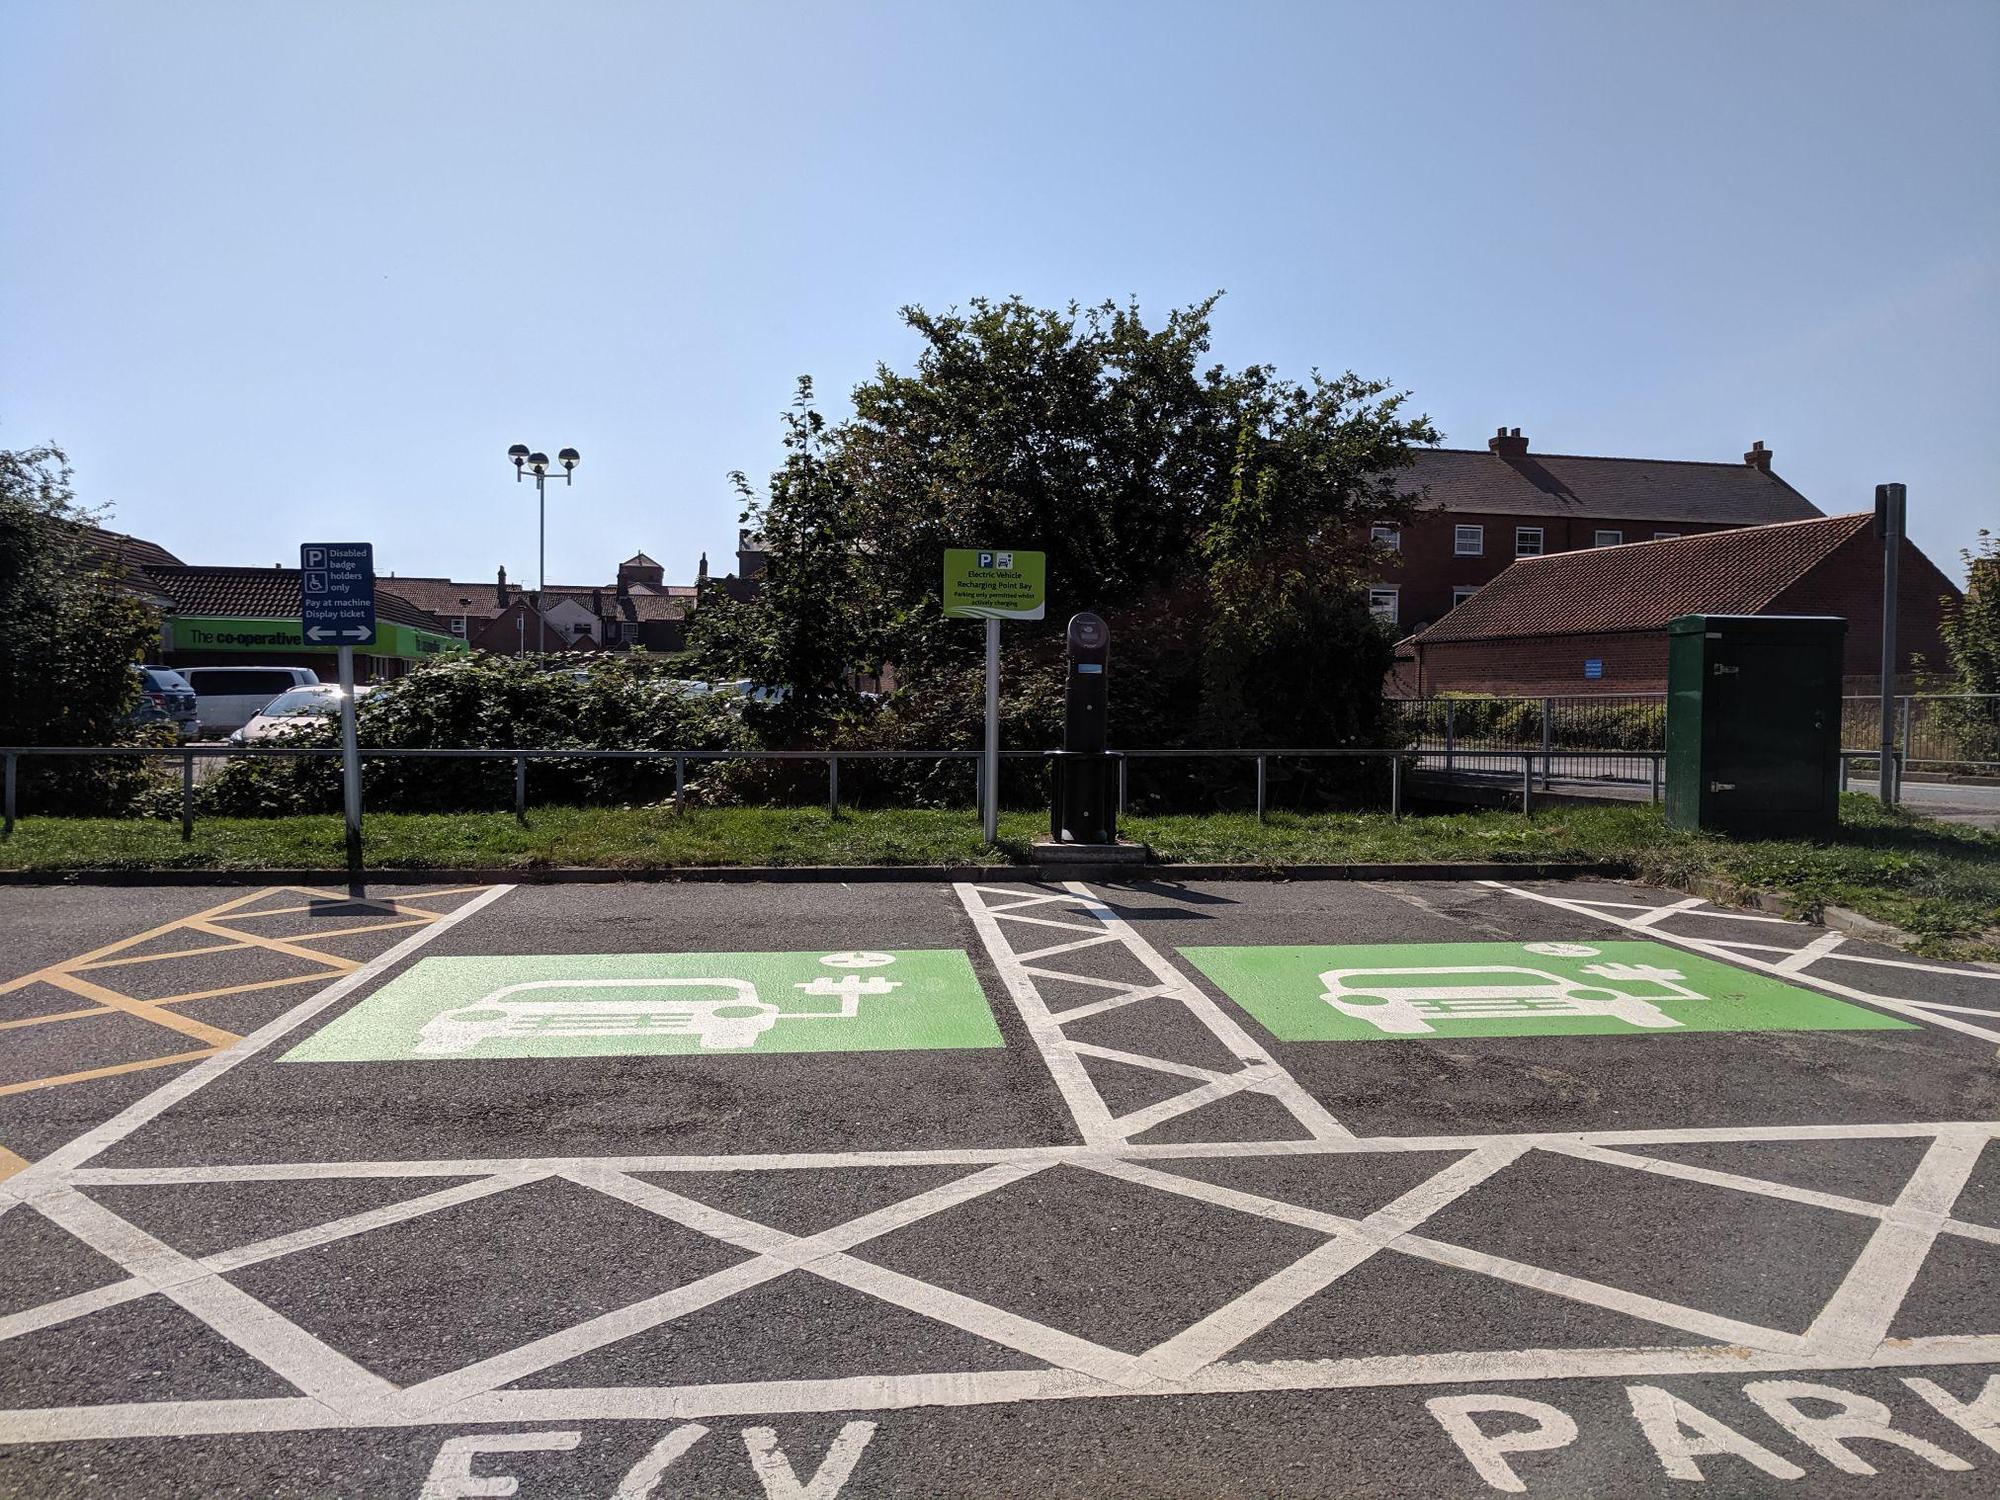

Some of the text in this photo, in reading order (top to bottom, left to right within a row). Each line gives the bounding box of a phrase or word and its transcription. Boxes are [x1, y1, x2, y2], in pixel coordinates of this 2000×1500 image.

[329, 549, 367, 557] Disabled
[309, 551, 322, 566] P
[981, 554, 991, 567] P
[330, 561, 356, 570] badge
[330, 572, 362, 580] holders
[330, 583, 350, 593] only
[957, 581, 997, 590] Recharging
[1019, 583, 1032, 591] Bay
[305, 599, 321, 609] Pay
[334, 599, 371, 607] machine
[305, 610, 365, 619] Display ticket
[190, 629, 302, 646] The co-operative
